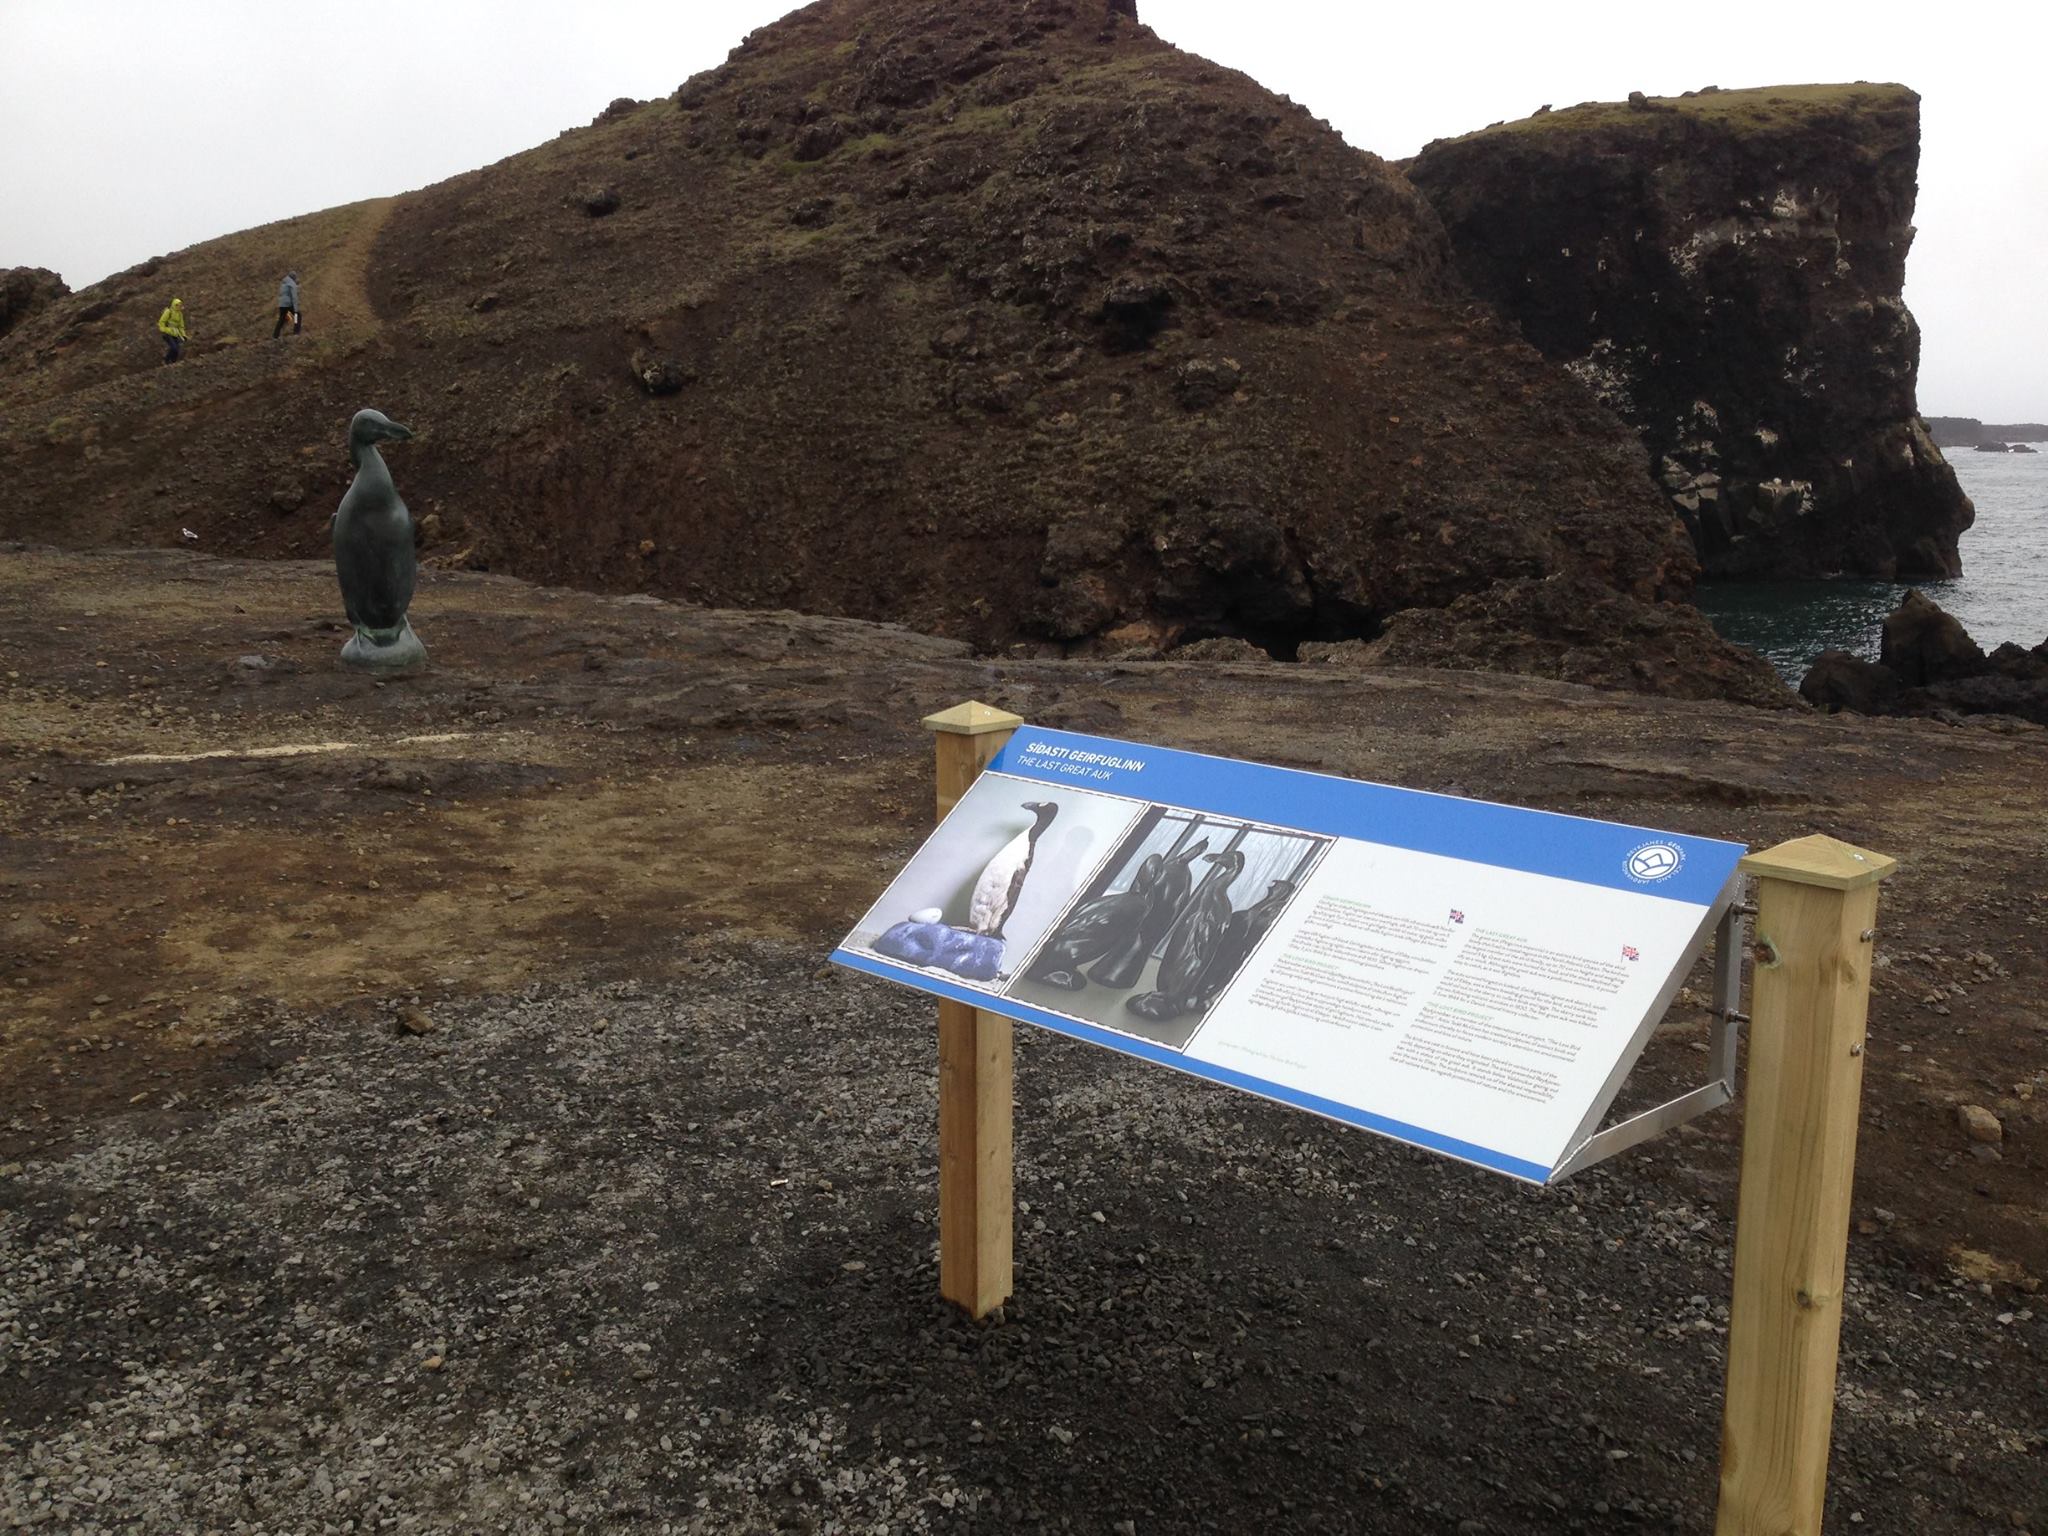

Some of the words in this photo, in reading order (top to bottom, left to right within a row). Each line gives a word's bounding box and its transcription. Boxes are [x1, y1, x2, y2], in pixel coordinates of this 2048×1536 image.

[1016, 755, 1036, 766] THE
[1034, 759, 1060, 772] LAST
[1059, 762, 1092, 777] GREAT
[1090, 769, 1113, 780] AUK
[1068, 750, 1145, 772] GEIRFUGLINN
